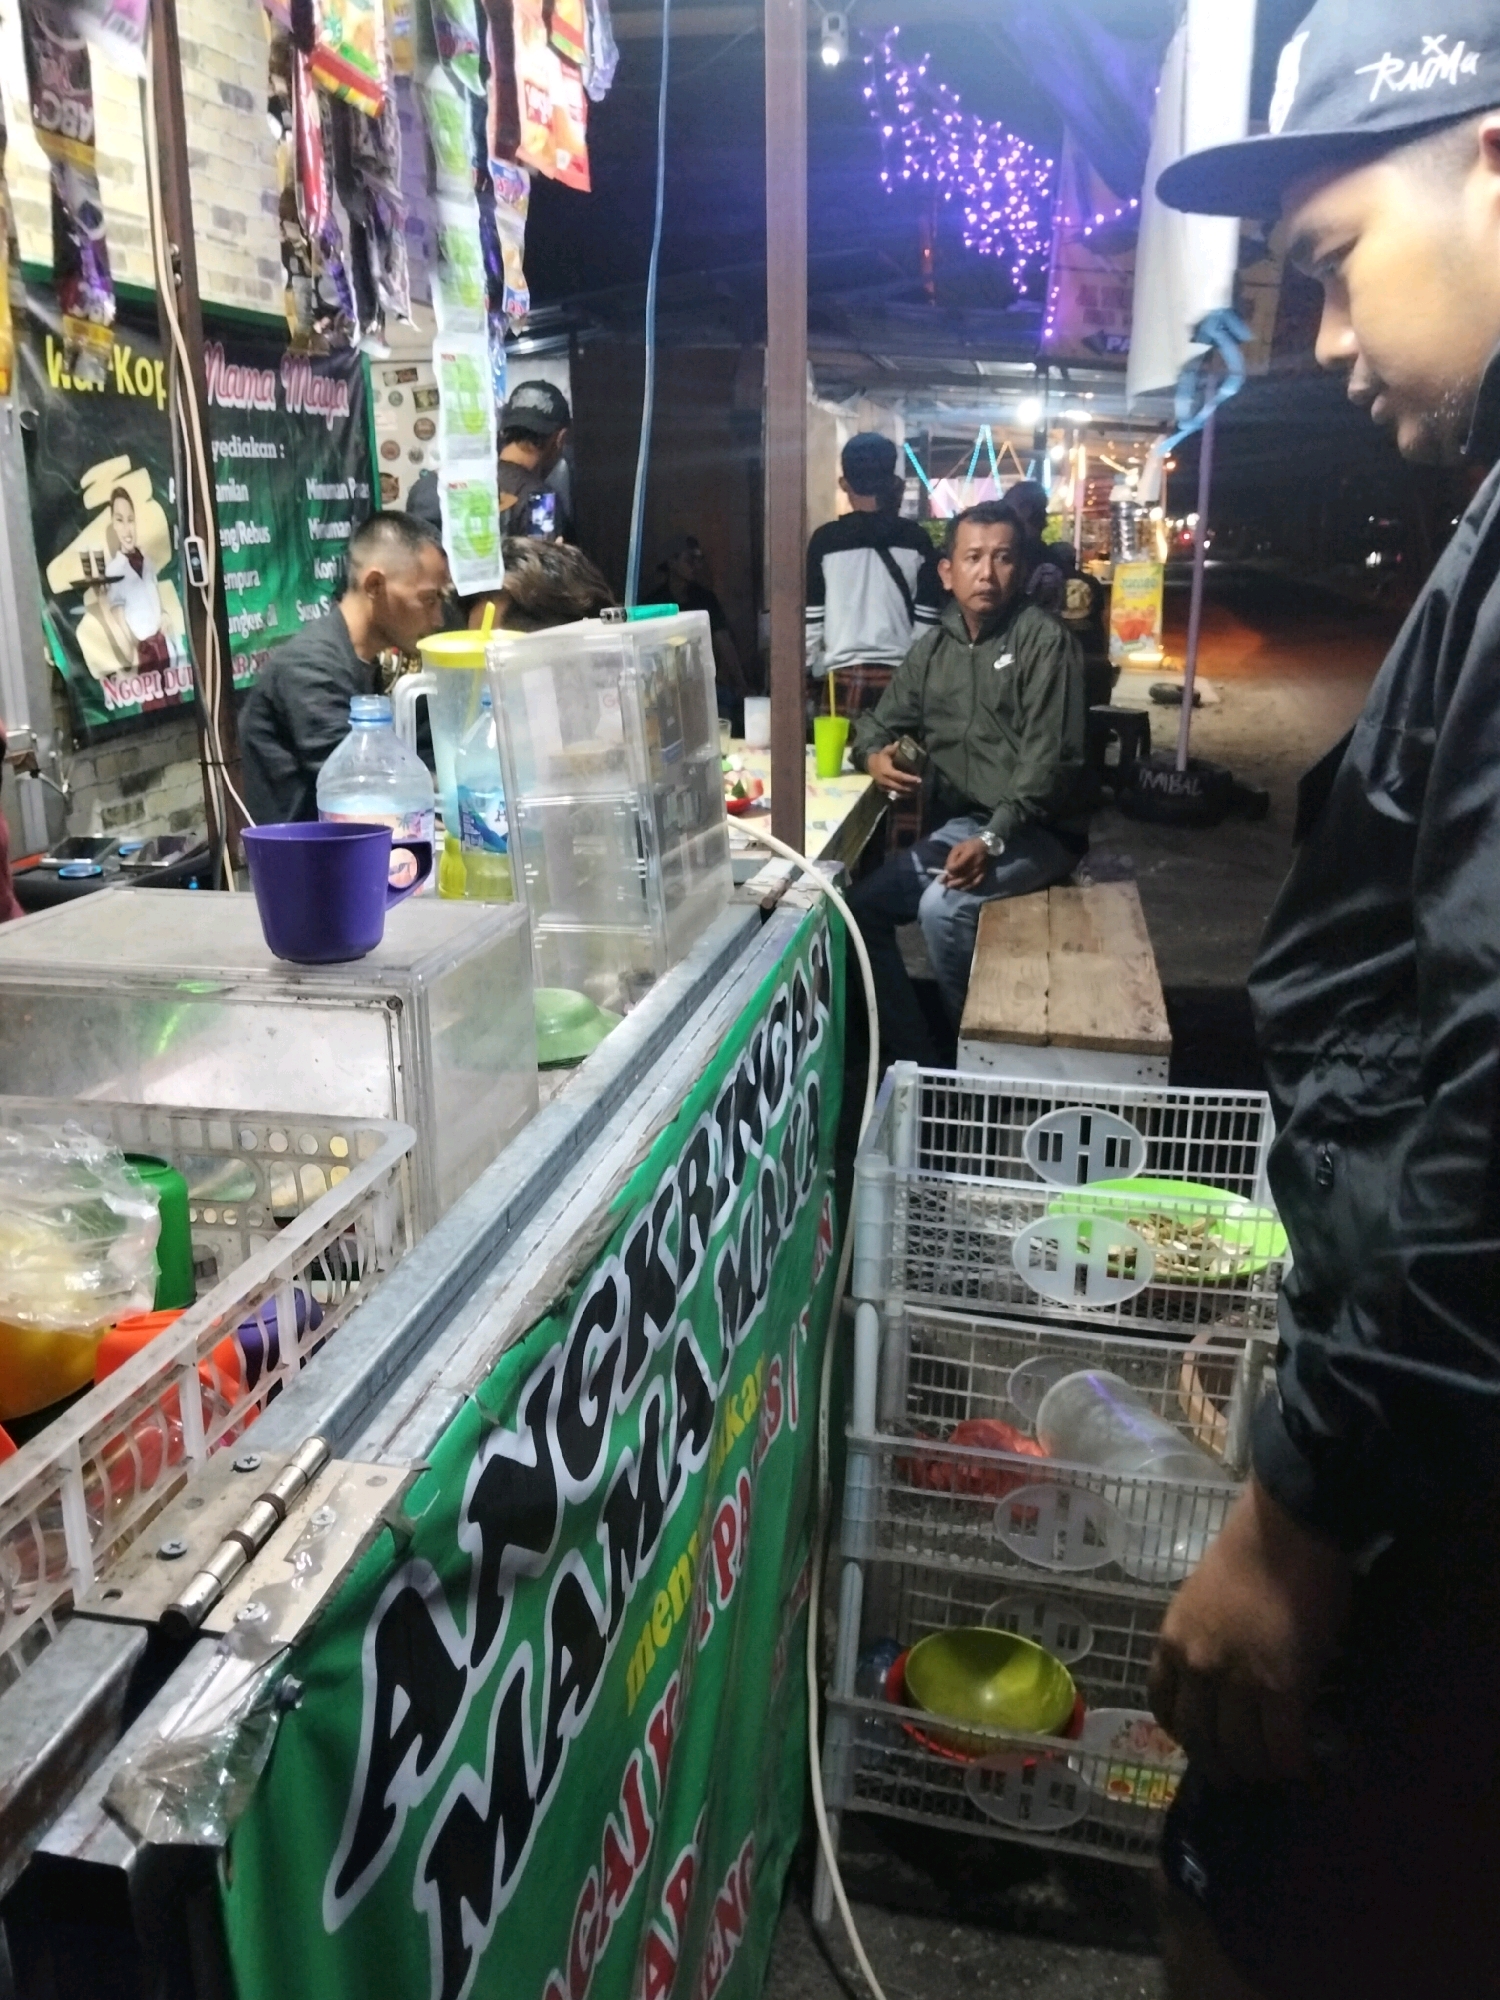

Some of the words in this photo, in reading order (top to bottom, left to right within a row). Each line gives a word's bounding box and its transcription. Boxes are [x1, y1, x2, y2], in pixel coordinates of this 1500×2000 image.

[281, 353, 350, 432] Maya
[211, 434, 277, 463] yediakan
[215, 476, 249, 502] amilan
[223, 570, 261, 596] empura
[102, 669, 163, 711] NGOPI
[323, 914, 833, 1934] ANGKRINGAN
[413, 1318, 722, 2000] MAMA
